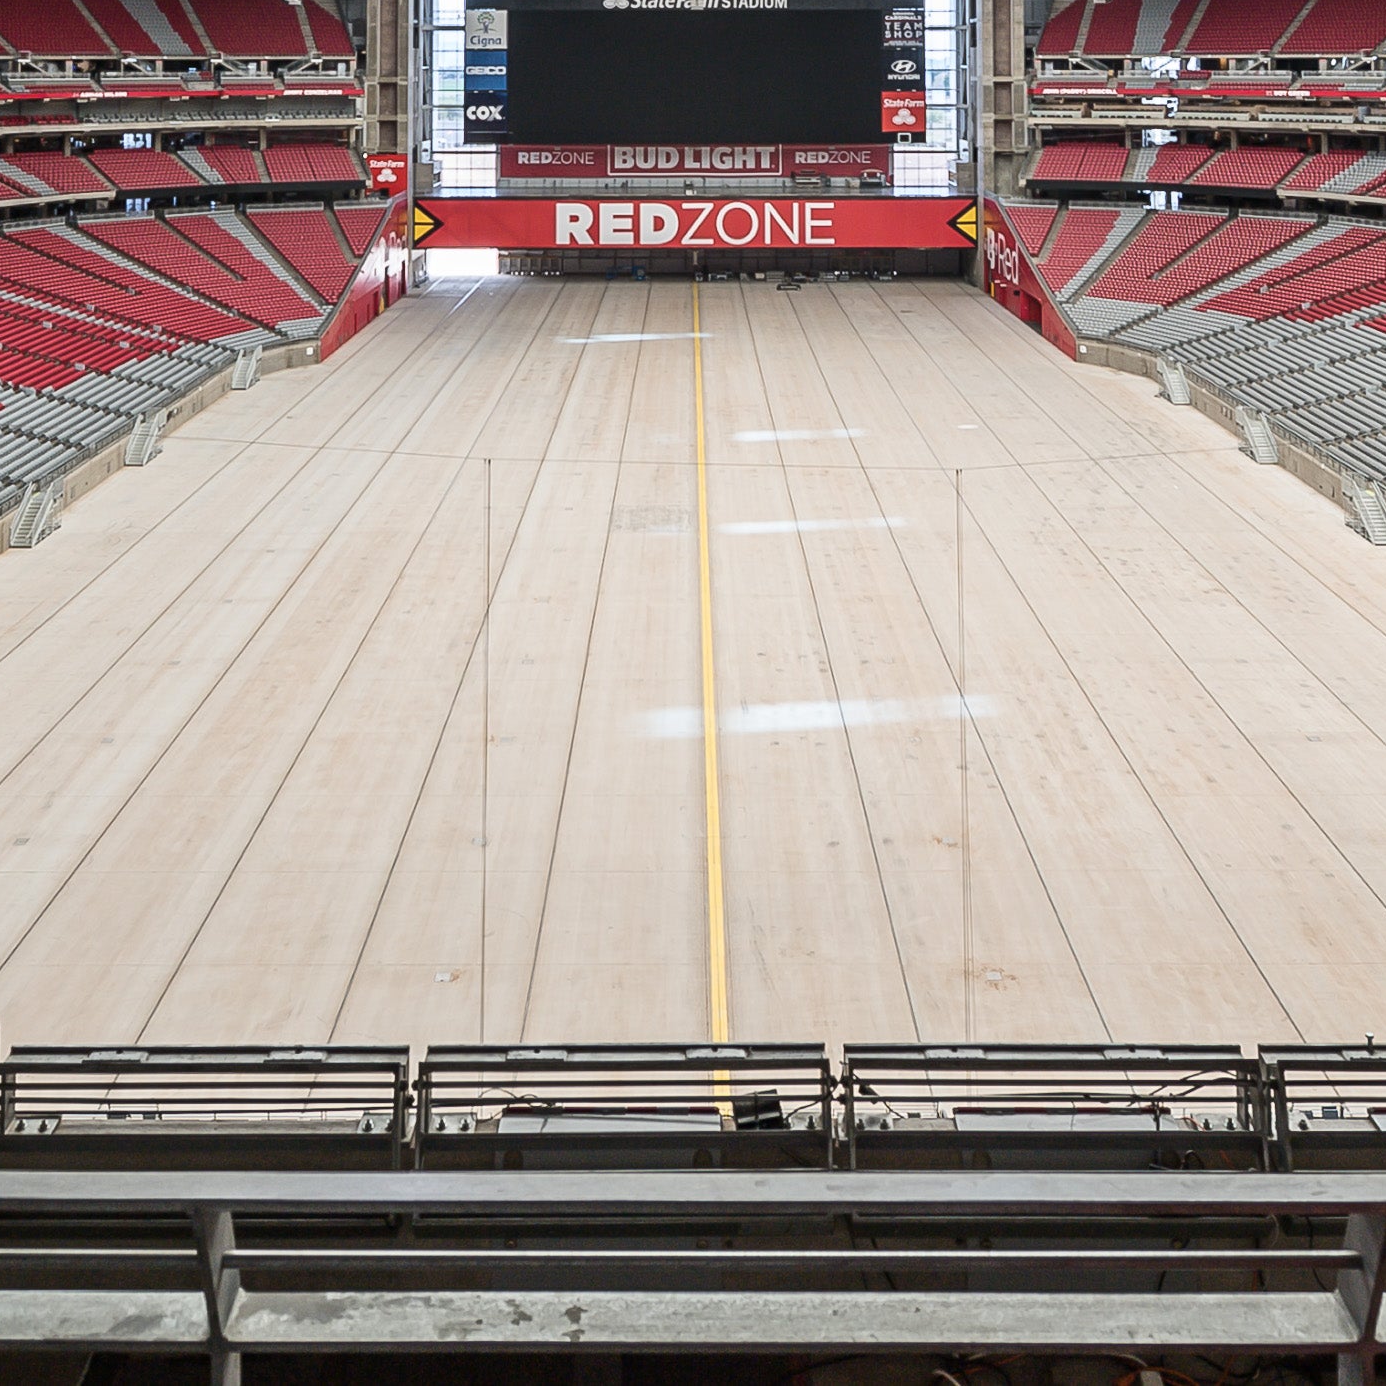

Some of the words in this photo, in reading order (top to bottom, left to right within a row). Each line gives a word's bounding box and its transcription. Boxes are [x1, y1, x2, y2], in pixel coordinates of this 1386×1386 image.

[884, 21, 923, 31] TEAM
[469, 35, 502, 47] Cigna
[884, 30, 923, 38] SHOP
[883, 98, 905, 108] State
[904, 99, 925, 107] Farm
[466, 104, 504, 122] COX
[518, 150, 596, 165] REDZONE
[614, 147, 680, 170] BUD
[684, 147, 773, 169] LIGHT
[794, 150, 872, 164] REDZONE
[555, 201, 835, 246] REDZONE
